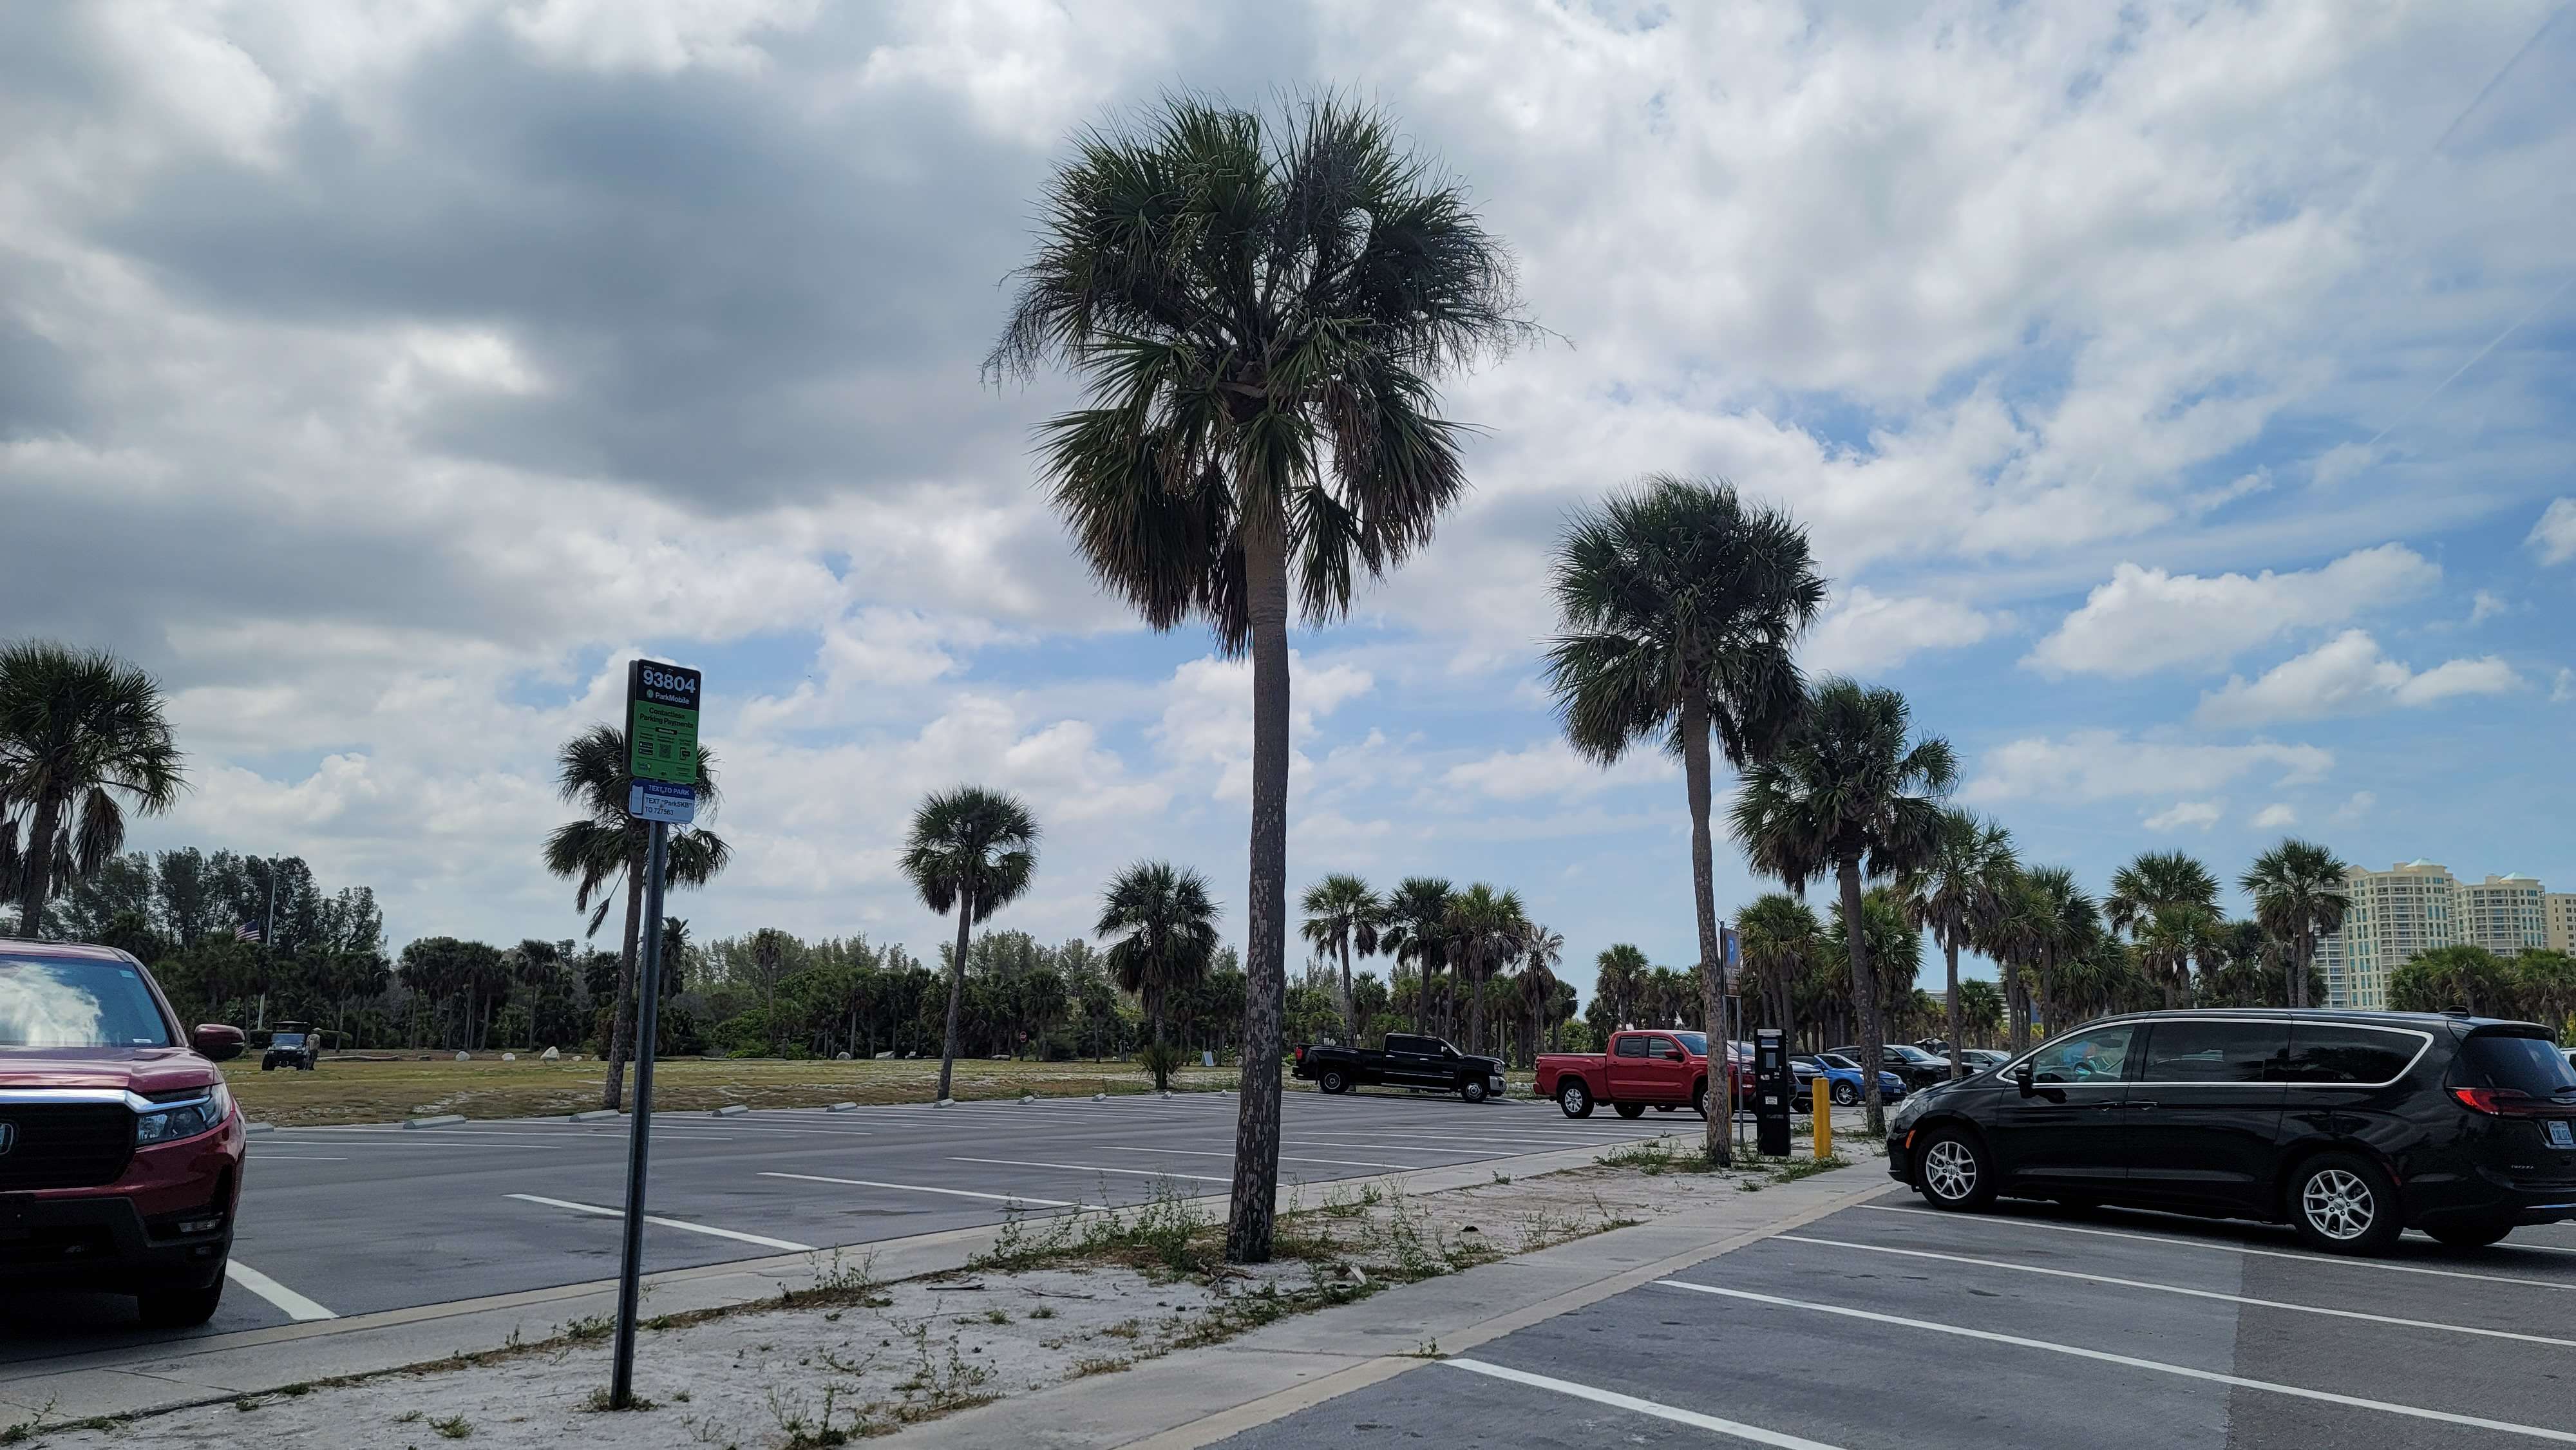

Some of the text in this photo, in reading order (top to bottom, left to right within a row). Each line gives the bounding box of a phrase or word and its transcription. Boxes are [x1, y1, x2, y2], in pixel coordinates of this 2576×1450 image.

[643, 669, 696, 693] 93804
[655, 692, 690, 704] ParkMobile
[639, 713, 694, 728] Parking Payments
[649, 707, 686, 719] Contactless
[1728, 939, 1734, 959] P
